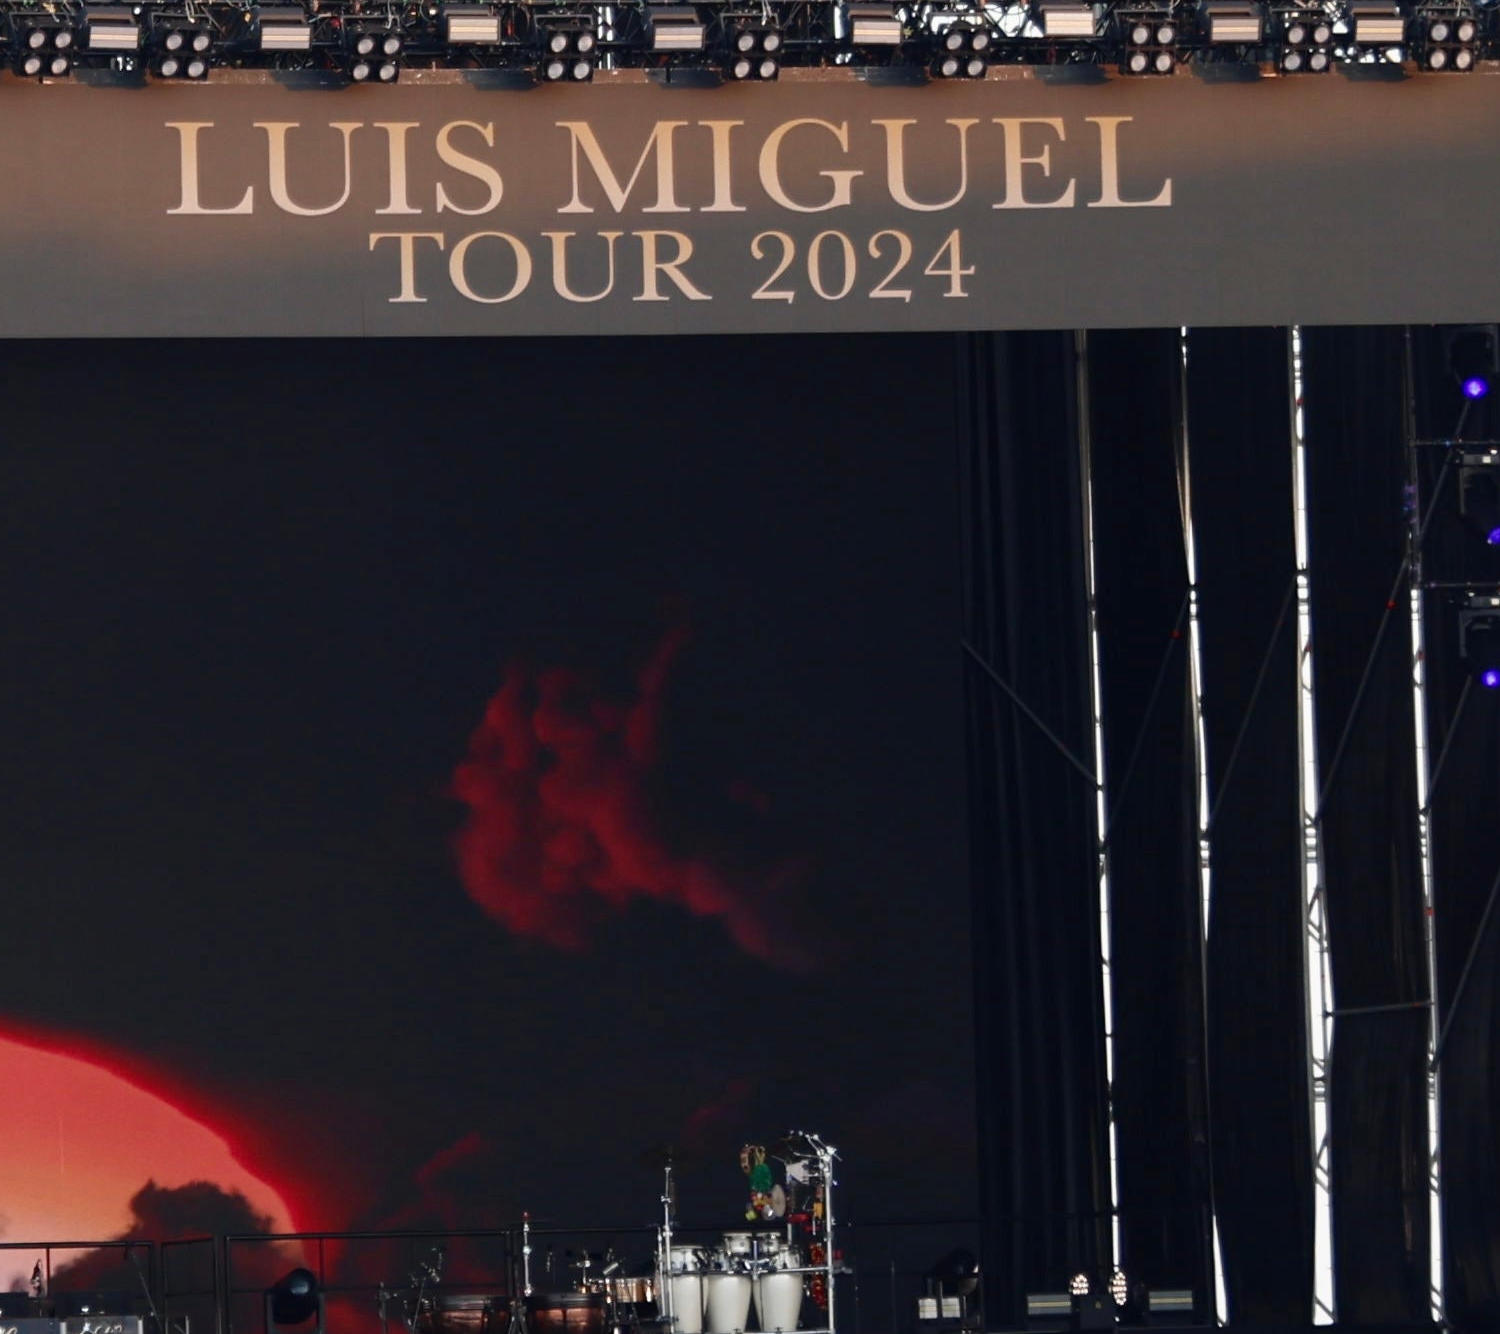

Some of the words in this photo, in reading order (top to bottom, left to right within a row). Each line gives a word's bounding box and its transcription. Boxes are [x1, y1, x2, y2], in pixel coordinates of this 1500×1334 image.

[164, 120, 504, 216] LUIS
[554, 116, 1172, 214] MIGUEL
[369, 230, 712, 304] TOUR
[750, 228, 976, 304] 2024
